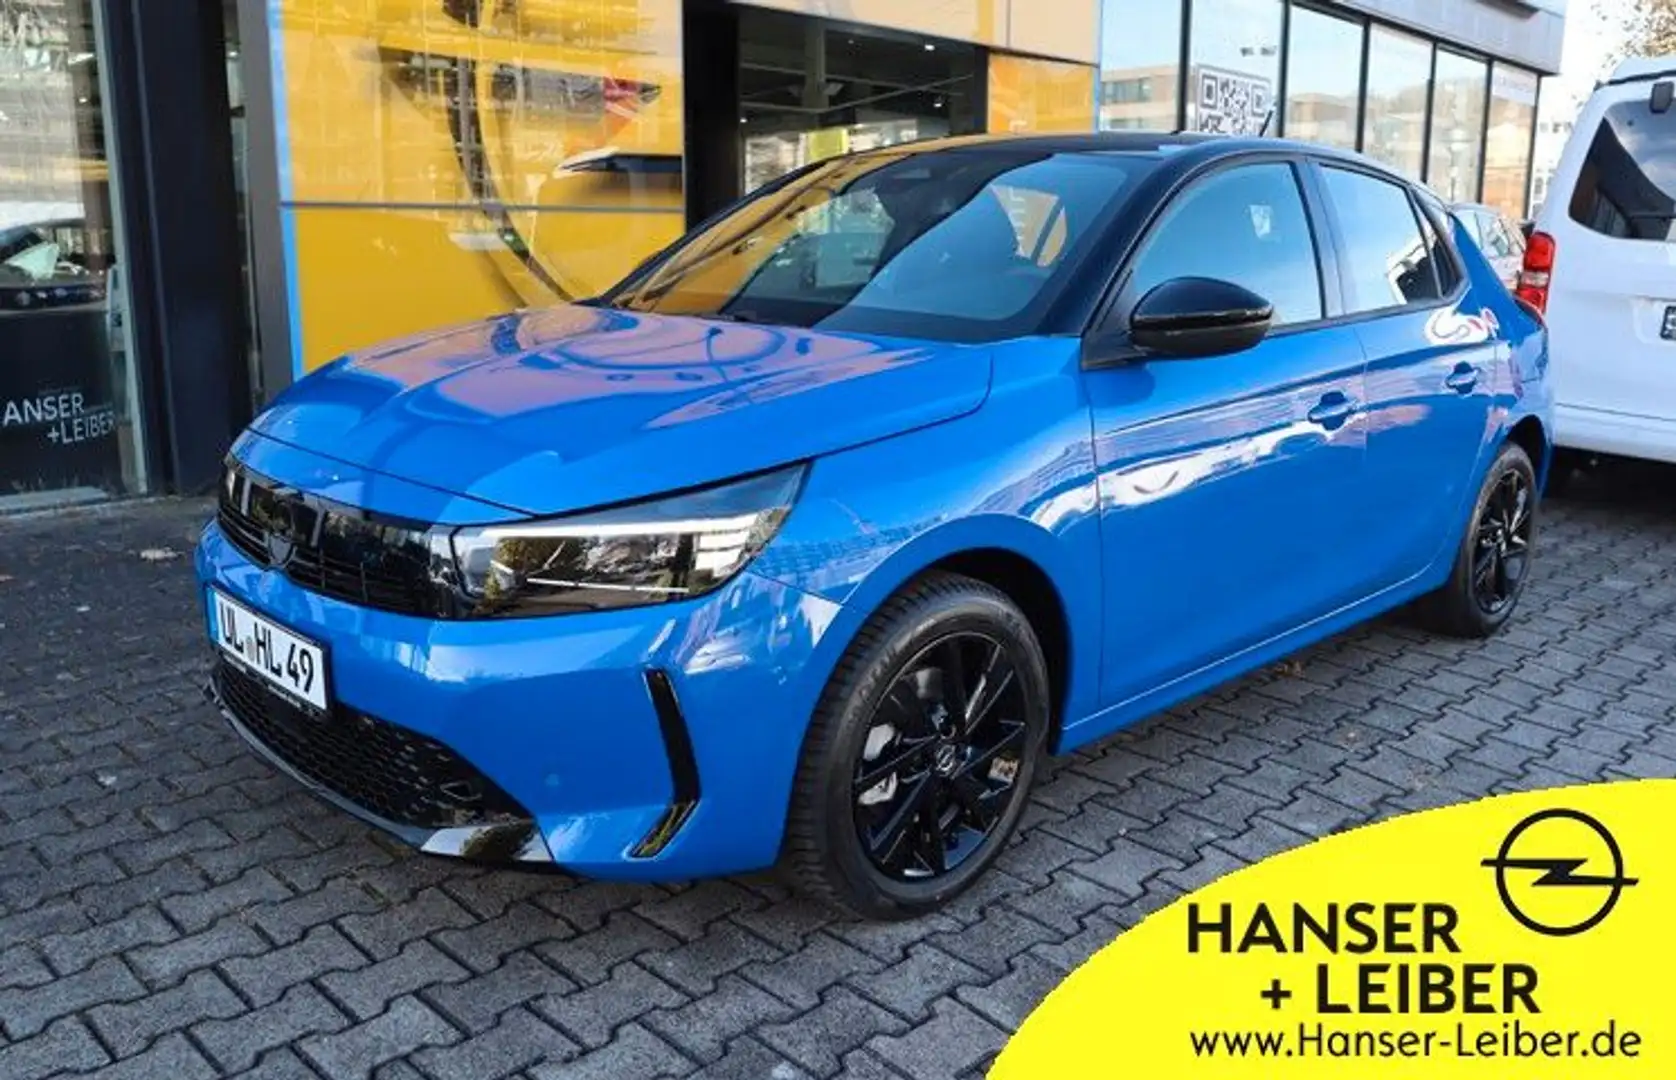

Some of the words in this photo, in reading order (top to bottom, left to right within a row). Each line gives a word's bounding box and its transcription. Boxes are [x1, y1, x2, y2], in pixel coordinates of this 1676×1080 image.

[221, 602, 244, 653] UL
[254, 621, 282, 678] HL
[287, 643, 314, 693] 49
